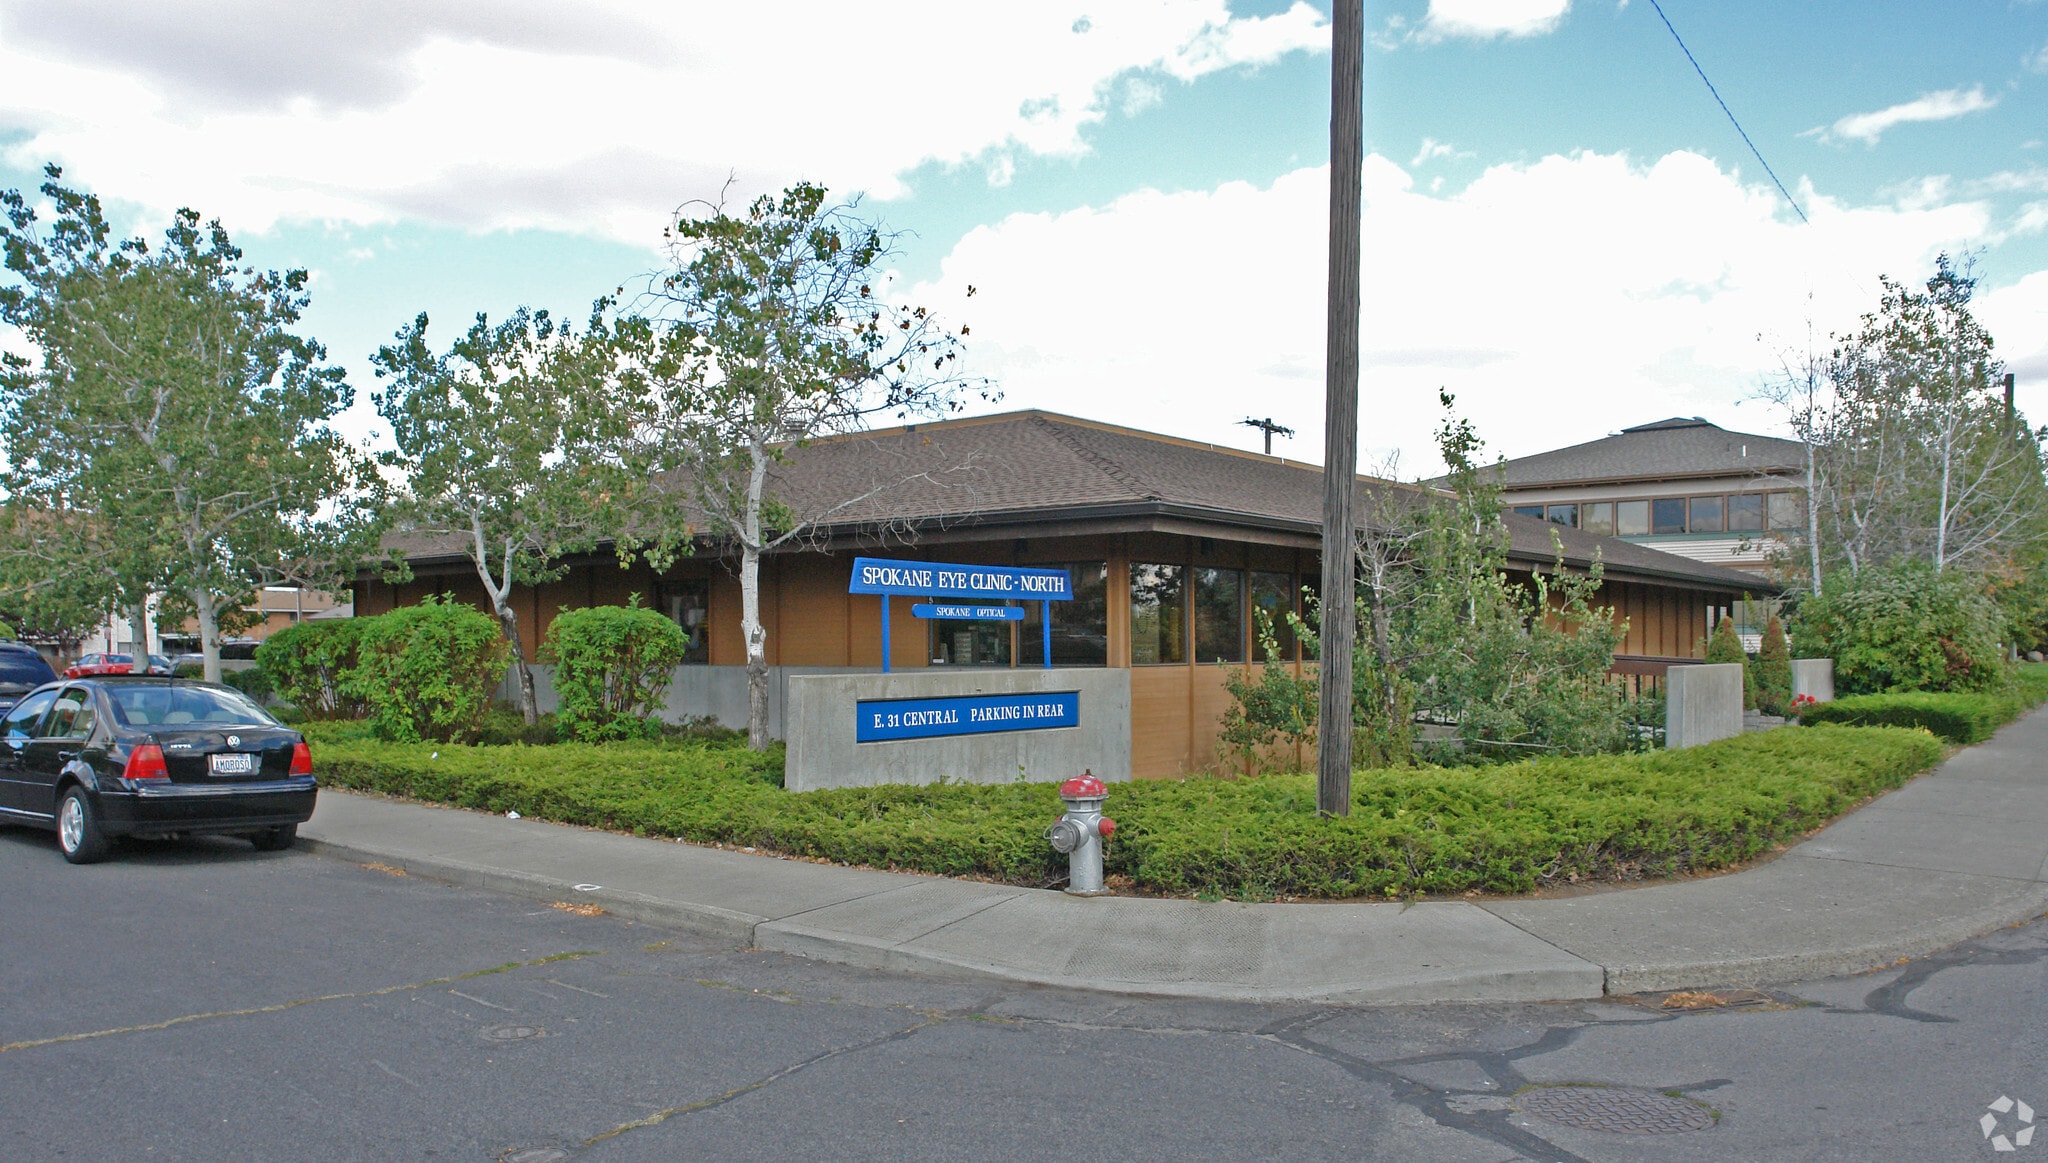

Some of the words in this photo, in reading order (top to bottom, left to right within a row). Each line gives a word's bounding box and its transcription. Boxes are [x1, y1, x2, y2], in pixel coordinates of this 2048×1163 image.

[863, 567, 932, 588] SPOKANE
[939, 571, 967, 588] EYE
[936, 607, 970, 617] SPOKANE
[976, 608, 1006, 618] OPTICAL
[874, 714, 885, 729] E.
[888, 714, 900, 728] 31
[903, 710, 959, 727] CENTRAL
[970, 706, 1020, 722] PARKING
[1023, 705, 1036, 719] IN
[1037, 704, 1064, 717] REAR
